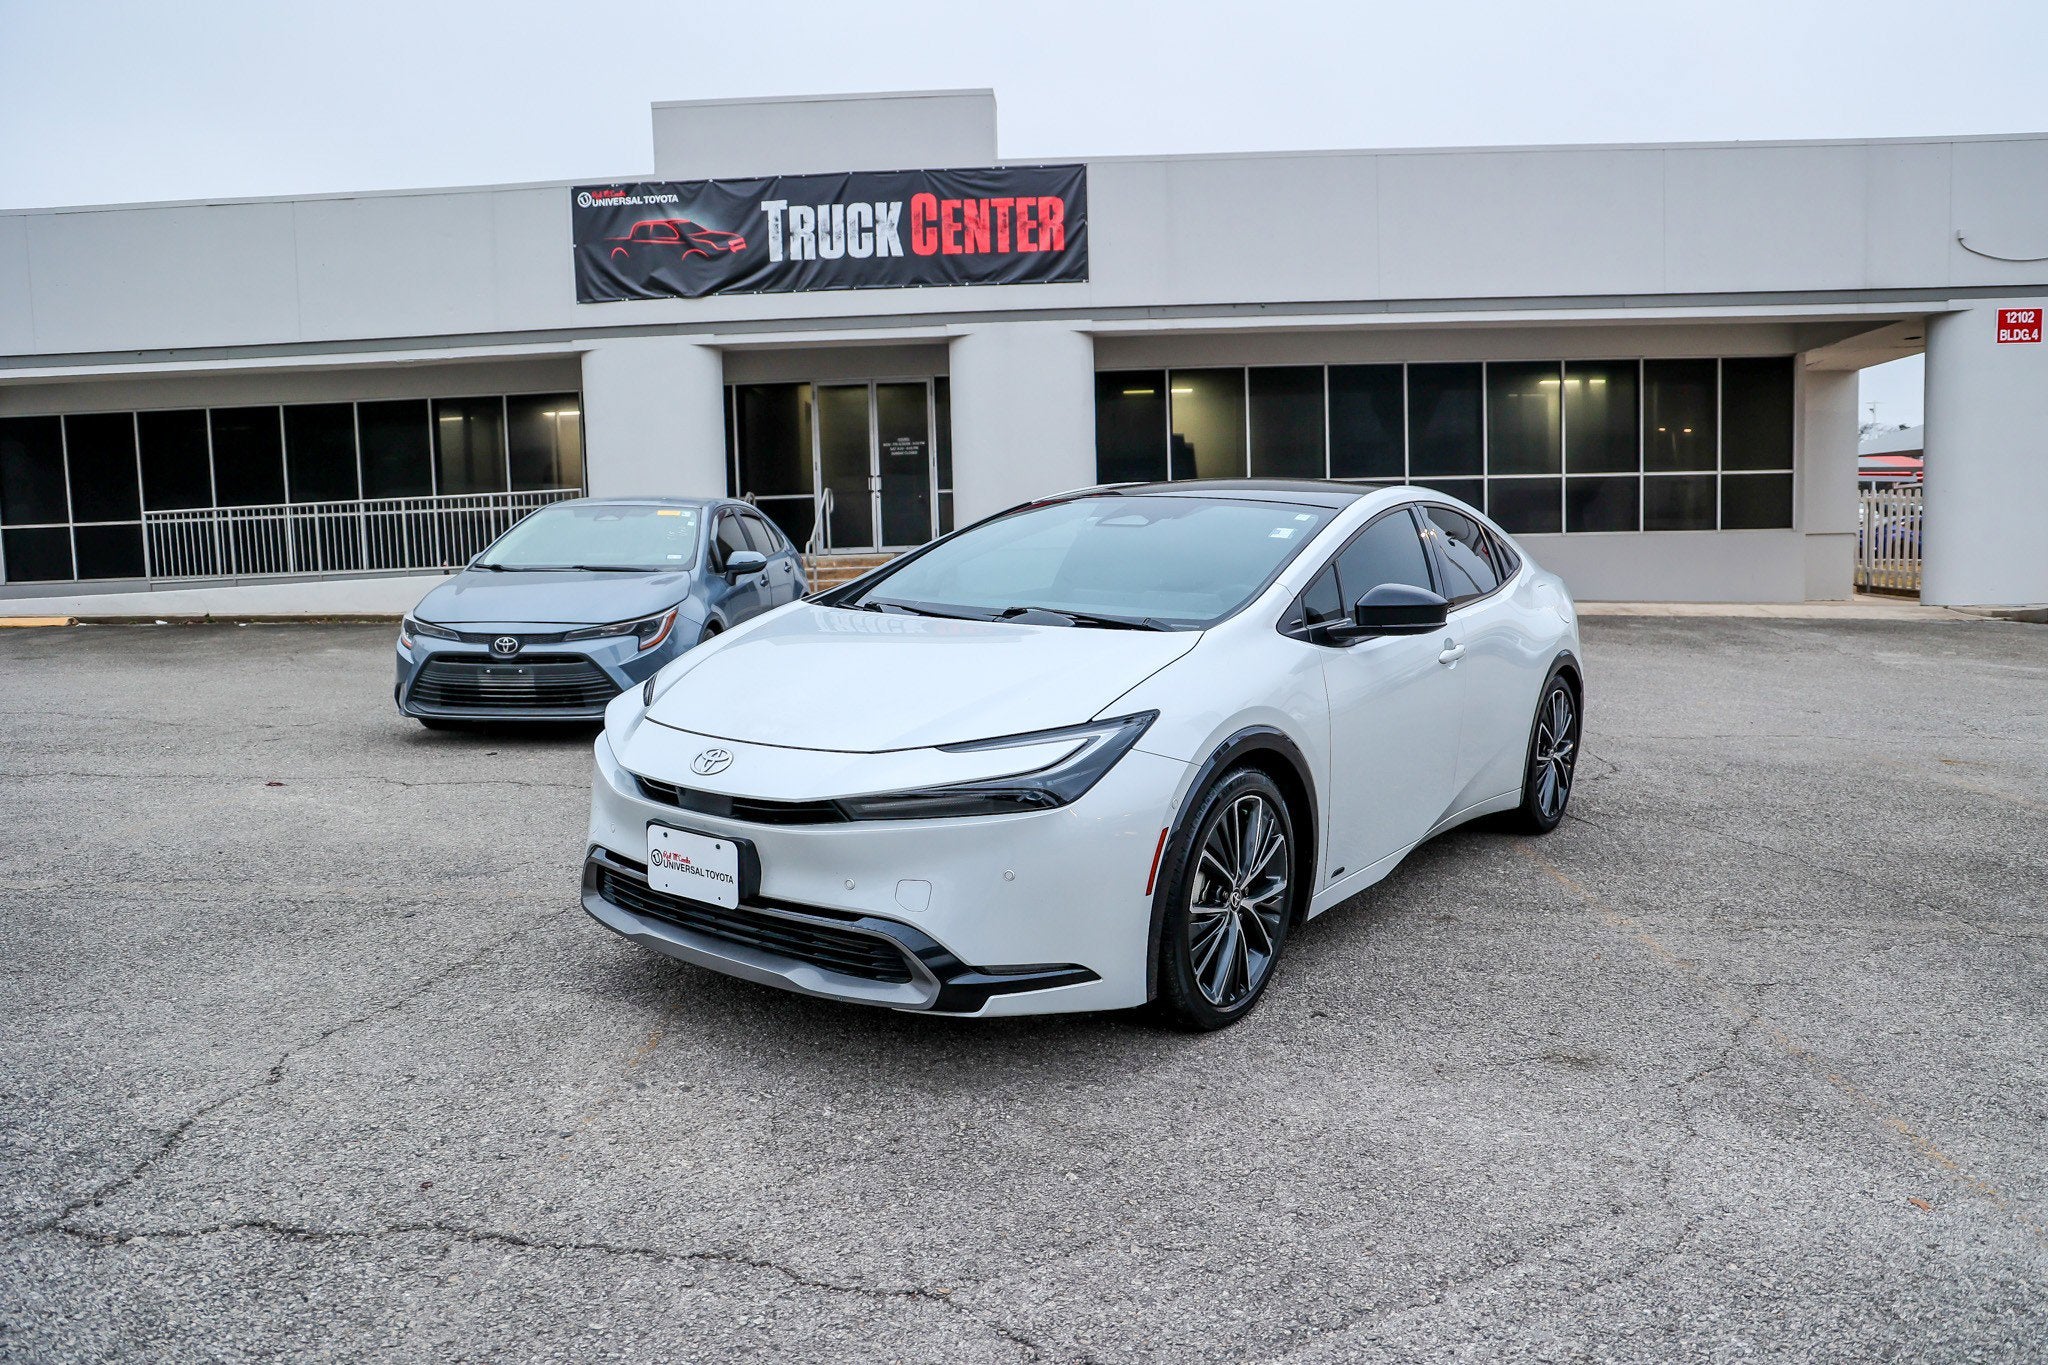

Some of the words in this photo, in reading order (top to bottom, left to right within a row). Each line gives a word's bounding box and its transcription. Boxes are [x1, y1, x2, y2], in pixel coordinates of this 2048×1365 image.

[592, 196, 643, 207] UNIVERSAL
[643, 194, 679, 205] TOYOTA
[761, 199, 904, 262] TRUCK
[910, 192, 1065, 256] CENTER
[2005, 311, 2035, 324] 12102
[663, 859, 704, 877] UNIVERSAL
[705, 869, 734, 884] TOYOTA
